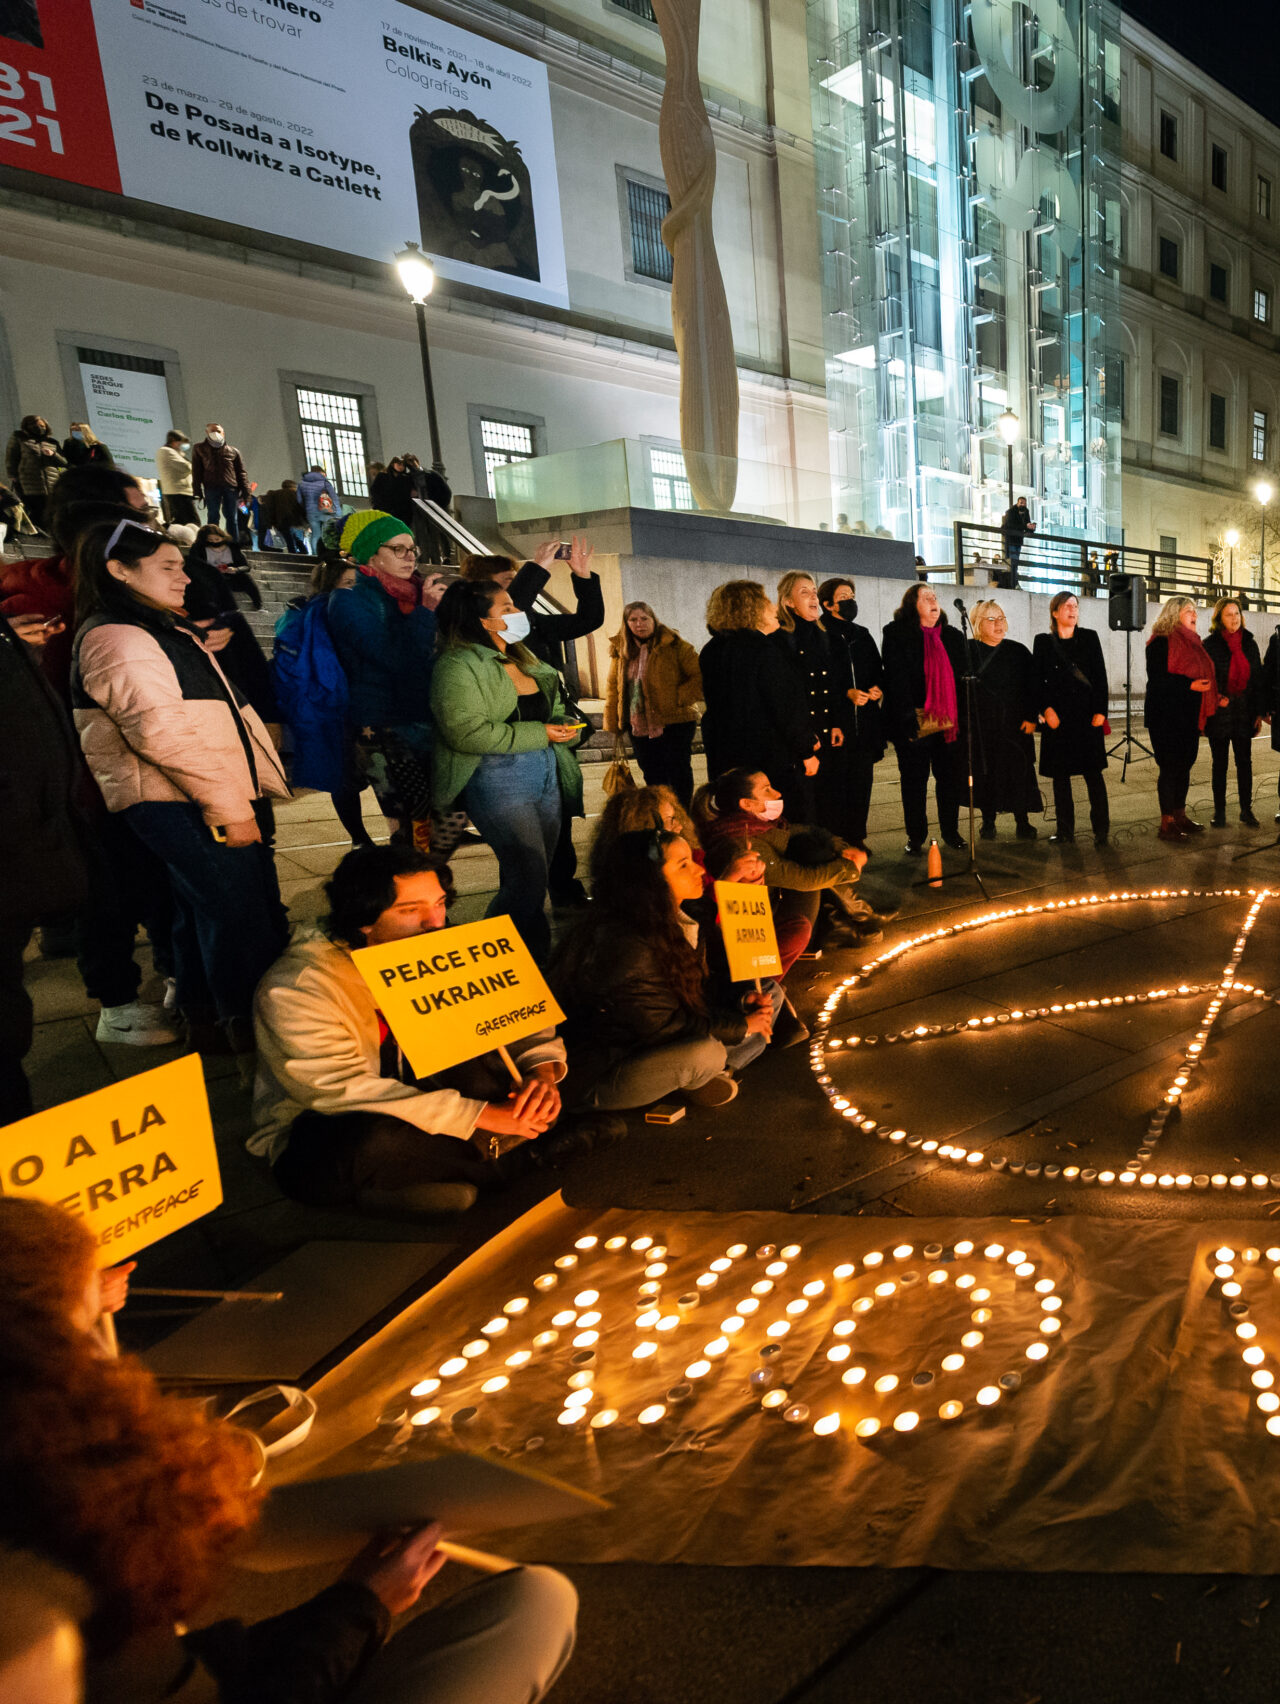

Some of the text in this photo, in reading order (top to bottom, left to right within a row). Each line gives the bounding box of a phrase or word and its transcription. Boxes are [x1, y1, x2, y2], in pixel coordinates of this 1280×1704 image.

[158, 11, 187, 25] Madrid
[225, 0, 303, 39] de trovar
[265, 0, 322, 23] mero
[381, 21, 390, 31] 17
[392, 26, 402, 37] de
[404, 31, 445, 55] noviembre,
[447, 47, 467, 62] 2021
[475, 58, 484, 69] 18
[486, 64, 495, 74] de
[496, 68, 511, 80] abril
[512, 73, 533, 88] 2022
[383, 35, 492, 90] Belkis Ayón
[385, 58, 469, 101] Colografías
[0, 105, 65, 155] 21
[142, 75, 159, 87] 23
[160, 80, 174, 92] de
[176, 87, 209, 103] marzo
[219, 99, 233, 111] 29
[235, 105, 248, 116] de
[250, 111, 285, 129] agosto,
[287, 121, 314, 137] 2022
[145, 91, 382, 181] De Posada a Isotype,
[150, 120, 382, 201] de Kollwitz a Catlett
[91, 379, 123, 389] PARQUE
[93, 389, 120, 397] RETIRO
[97, 410, 125, 420] Carlos
[725, 900, 766, 916] NO A LAS
[736, 928, 766, 943] ARMAS
[379, 937, 515, 988] PEACE FOR
[411, 969, 520, 1015] UKRAINE
[475, 1000, 547, 1036] GREENPEACE
[0, 1104, 166, 1193] O A LA
[53, 1151, 178, 1218] ERRA
[98, 1179, 204, 1248] EENPEACE
[396, 1233, 1066, 1440] NO
